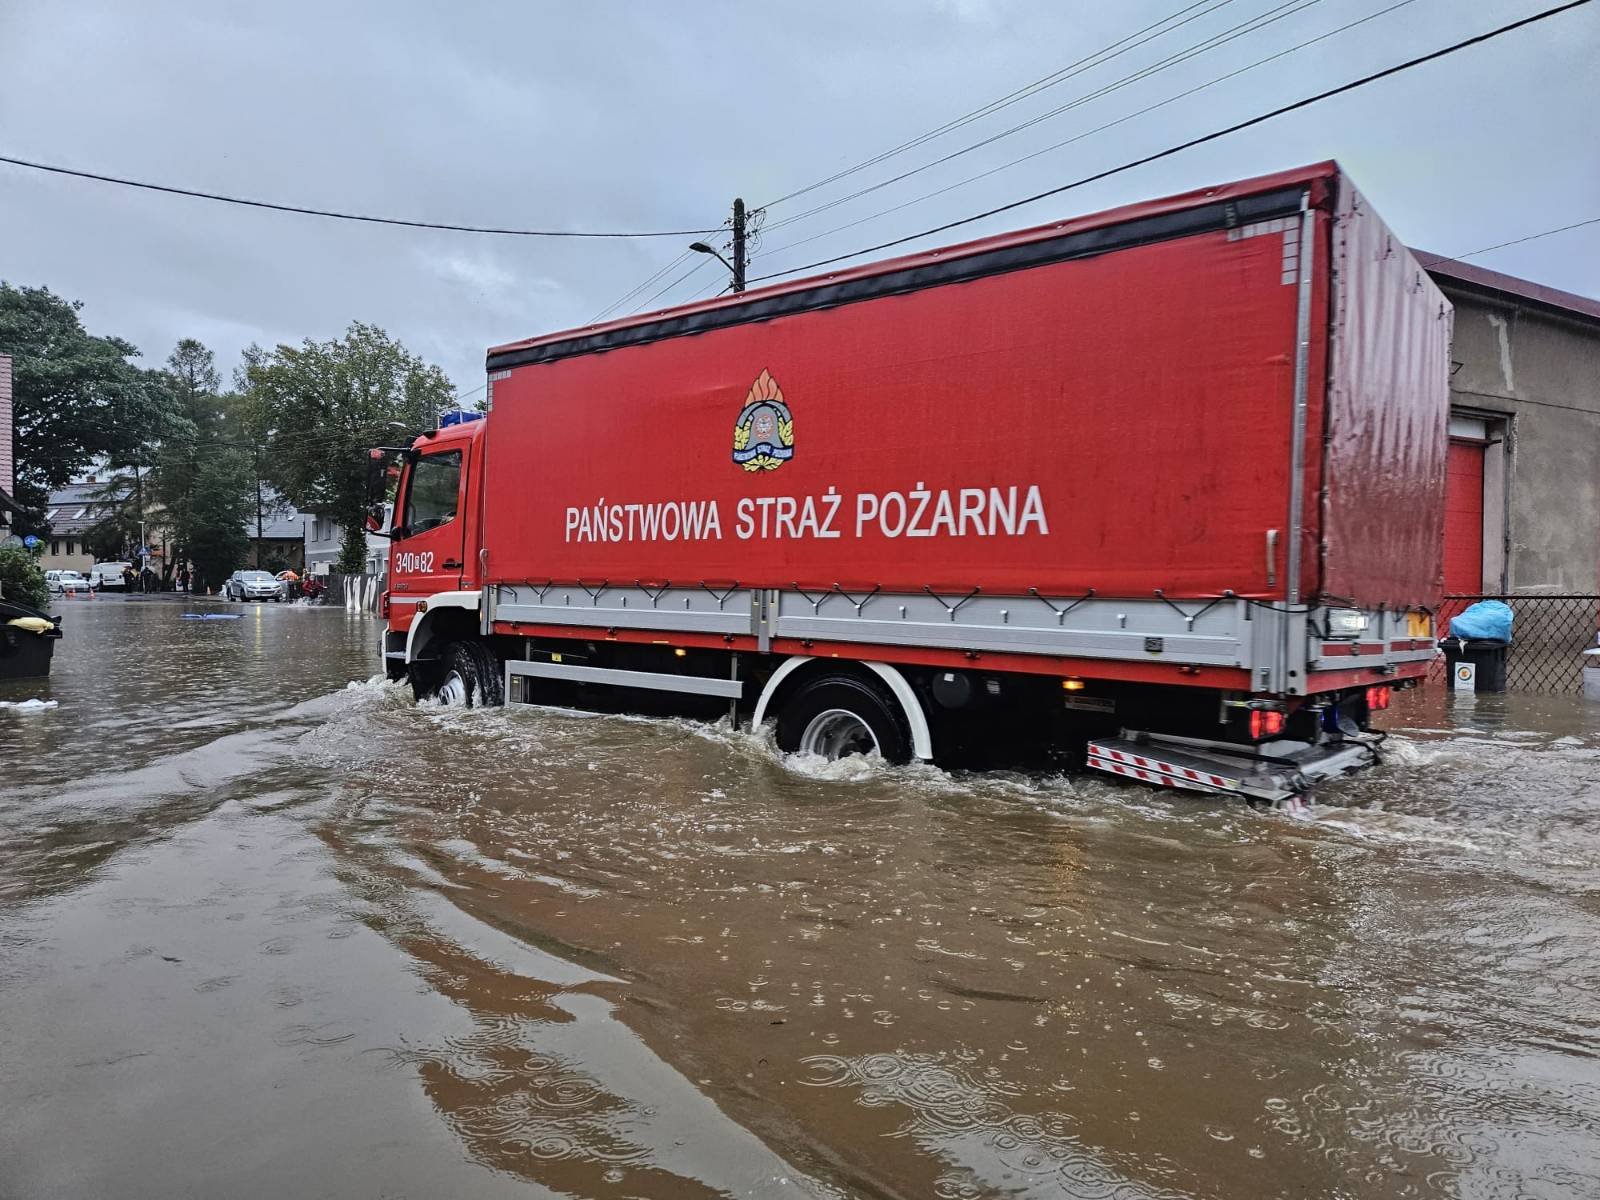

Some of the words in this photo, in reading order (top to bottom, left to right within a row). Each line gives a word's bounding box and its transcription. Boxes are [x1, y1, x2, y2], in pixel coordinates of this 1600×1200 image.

[565, 498, 721, 543] PAŃSTWOWA
[736, 485, 841, 539] STRAŻ
[855, 481, 1049, 538] POŻARNA
